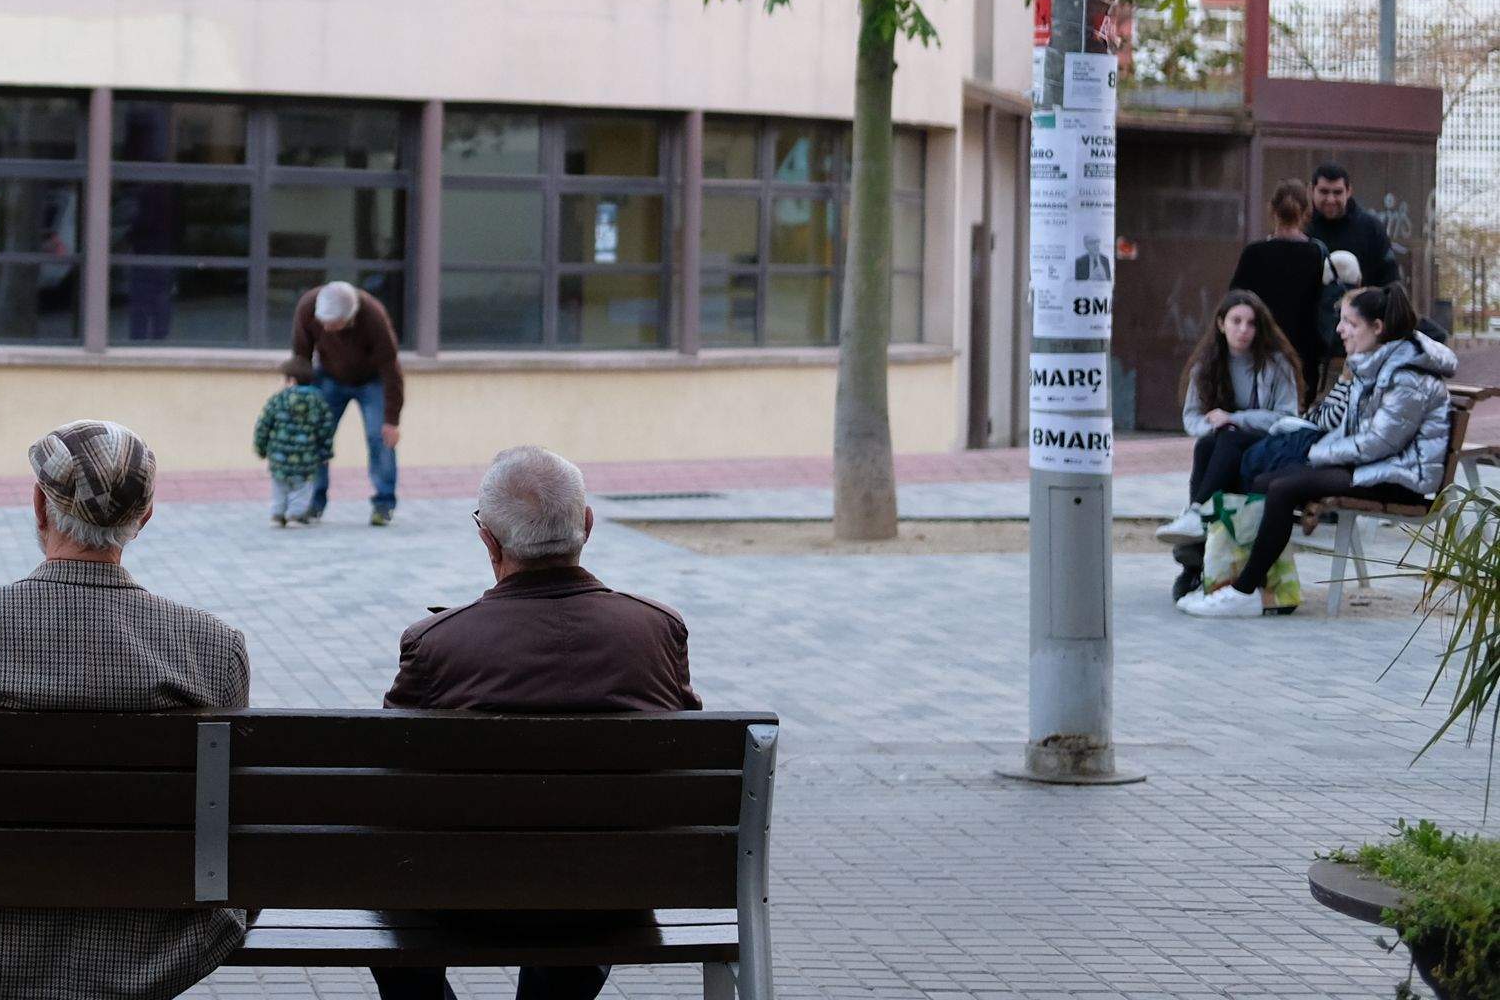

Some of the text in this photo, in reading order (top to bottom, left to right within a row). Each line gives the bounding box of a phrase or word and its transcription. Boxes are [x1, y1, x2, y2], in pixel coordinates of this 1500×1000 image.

[1031, 148, 1054, 159] RRO
[1091, 149, 1116, 158] NAV
[1073, 296, 1111, 316] 8M
[1033, 426, 1111, 457] 8MARÇ
